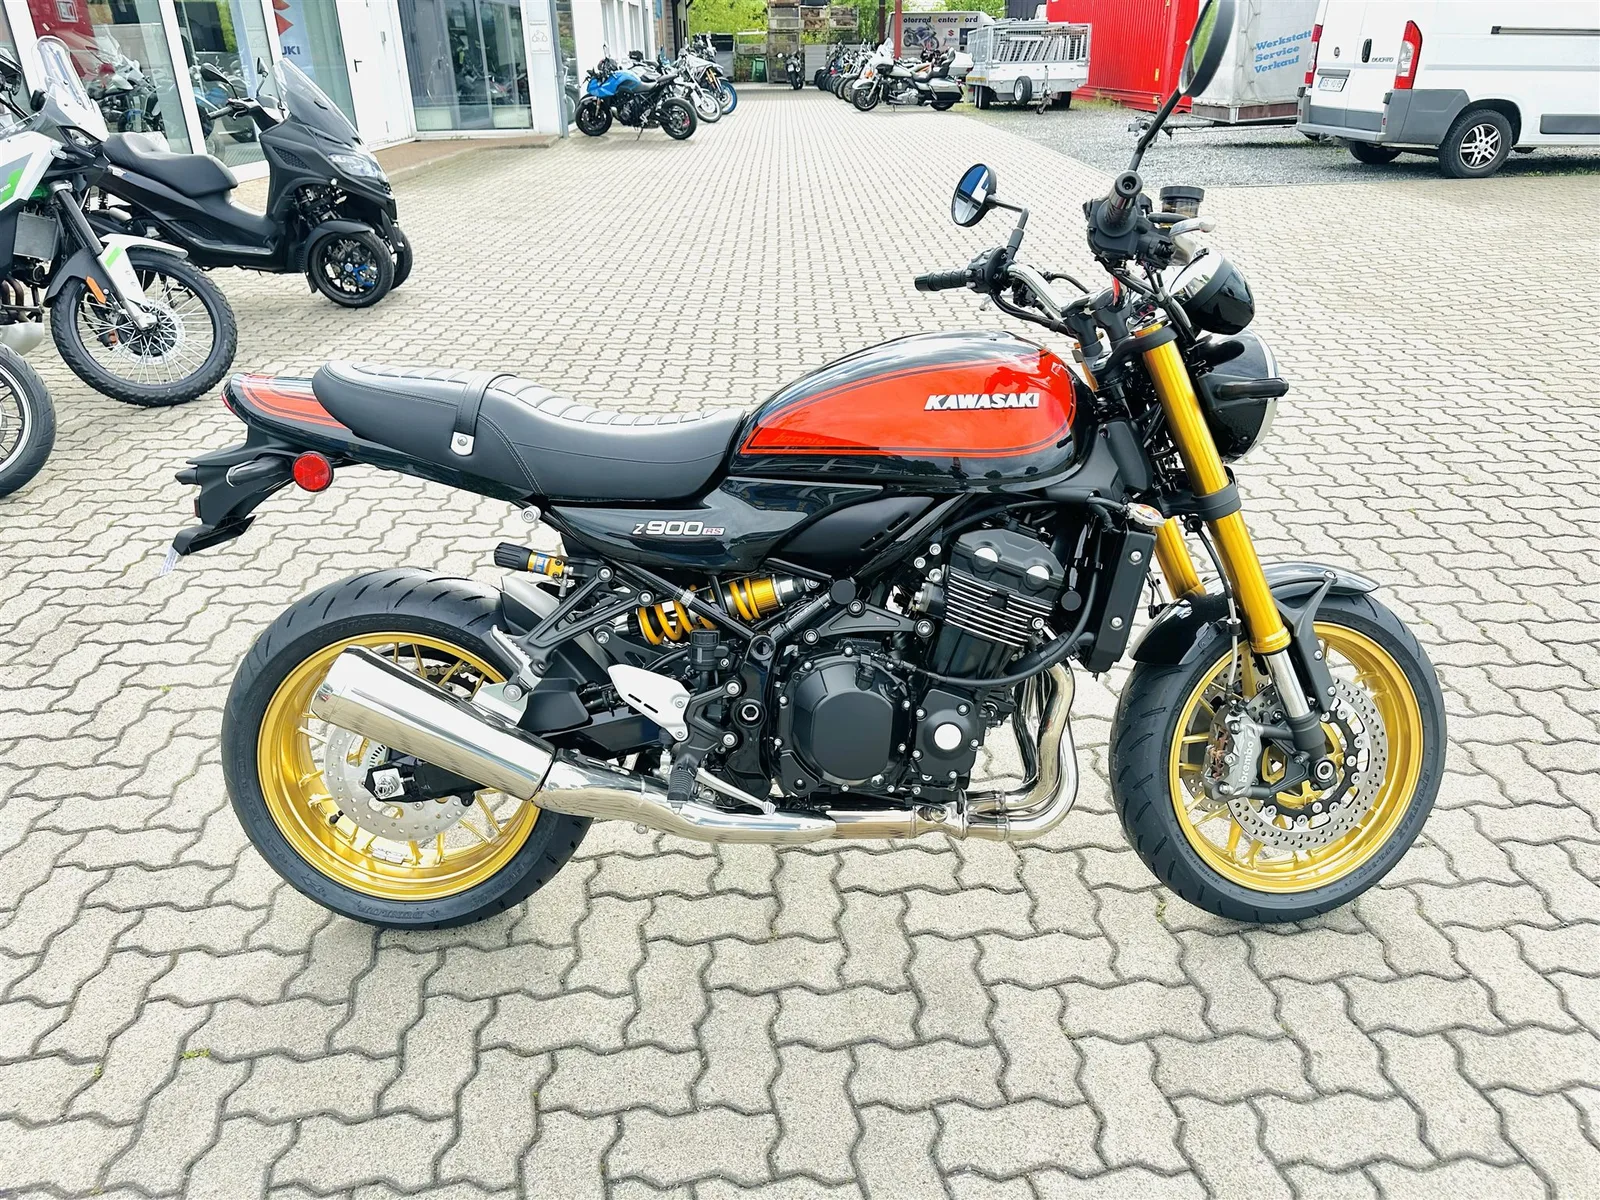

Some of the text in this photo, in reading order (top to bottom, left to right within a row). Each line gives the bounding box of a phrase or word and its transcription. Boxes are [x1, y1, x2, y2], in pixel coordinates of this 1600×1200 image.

[1255, 30, 1312, 51] Werkstatt
[281, 45, 301, 56] UKI
[1254, 46, 1300, 63] Service
[1254, 55, 1300, 73] Verkauf
[924, 392, 1040, 411] KAWASAKI
[1240, 741, 1254, 783] brembo
[357, 905, 424, 919] DUNLOP
